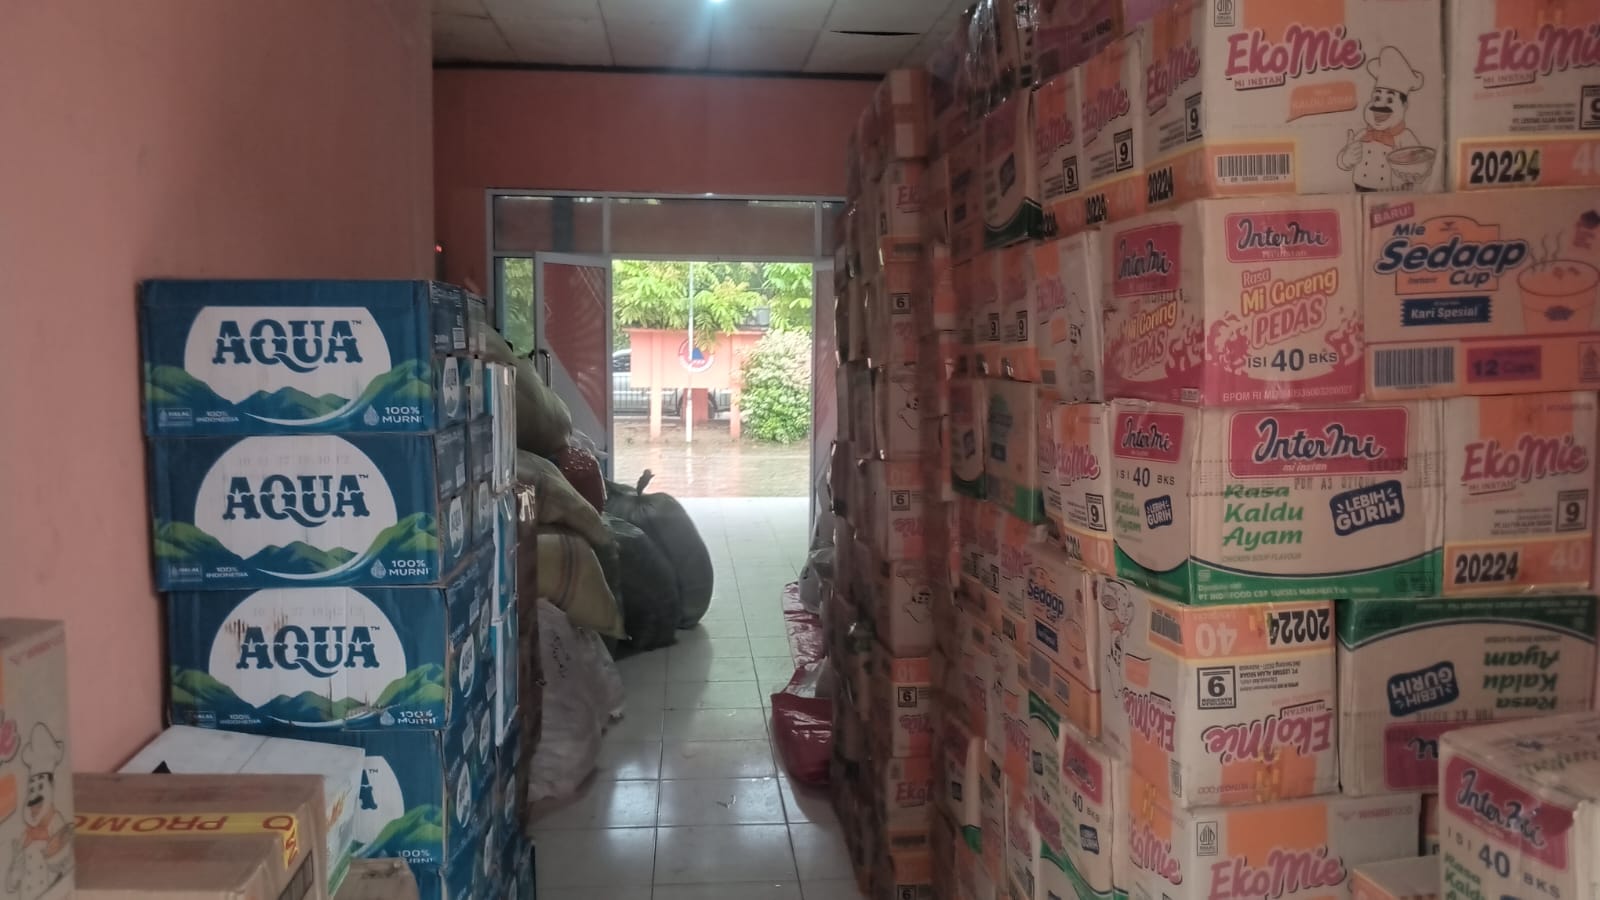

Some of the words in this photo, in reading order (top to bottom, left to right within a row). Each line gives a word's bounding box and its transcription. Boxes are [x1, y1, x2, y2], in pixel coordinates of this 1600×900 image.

[1225, 24, 1365, 78] EkoMie
[1190, 108, 1199, 130] 9
[1119, 143, 1129, 162] 9
[1066, 167, 1074, 185] 9
[1470, 150, 1540, 184] 20224
[1374, 205, 1413, 224] BARU!
[1238, 218, 1329, 251] InterMi
[1393, 224, 1426, 237] Mie
[1375, 236, 1528, 274] Sedaap
[1242, 269, 1270, 287] Rasa
[1449, 270, 1490, 288] Cup
[1243, 291, 1267, 315] Mi
[1270, 268, 1338, 305] Goreng
[1254, 296, 1327, 347] PEDAS
[1411, 308, 1435, 320] Kari
[1437, 306, 1478, 319] Spesial
[212, 318, 363, 373] AQUA
[1248, 356, 1267, 368] ISI
[1270, 348, 1304, 372] 40
[1308, 352, 1338, 365] BKS
[1472, 359, 1498, 376] 12
[1223, 391, 1251, 402] BPOM
[1253, 390, 1263, 400] RI
[382, 415, 424, 424] MURNI
[384, 406, 420, 416] 100%
[1122, 416, 1174, 452] InterMi
[1253, 417, 1385, 462] InterMi
[1283, 464, 1296, 472] mi
[1298, 462, 1327, 472] instan
[1461, 433, 1589, 484] EkoMie
[1133, 467, 1151, 487] 40
[1157, 475, 1175, 486] BKS
[222, 474, 370, 528] AQUA
[1224, 485, 1290, 499] Rasa
[1345, 490, 1387, 511] LEBIH
[1089, 504, 1099, 523] 9
[1146, 511, 1172, 526] GURIH
[1224, 503, 1305, 523] Kaldu
[1336, 499, 1401, 531] GURIH
[1565, 502, 1580, 523] 9
[1222, 526, 1303, 551] Ayam
[391, 559, 427, 568] 100%
[1271, 552, 1302, 561] FLAVOUR
[1454, 552, 1519, 584] 20224
[1549, 542, 1585, 571] 40
[388, 567, 429, 577] MURNI
[1028, 579, 1065, 619] Sedaap
[1269, 608, 1330, 646] 20224
[1195, 622, 1239, 657] 40
[236, 625, 379, 678] AQUA
[1483, 644, 1560, 669] Ayam
[1391, 667, 1453, 698] GURIH
[1483, 673, 1559, 693] Kaldu
[1405, 687, 1445, 708] LEBIH
[1496, 695, 1558, 709] Rasa
[1203, 712, 1334, 764] EkoMie
[1072, 791, 1083, 813] 40
[1210, 849, 1346, 899] EkoMie
[1478, 844, 1511, 878] 40
[1523, 872, 1561, 899] BKS
